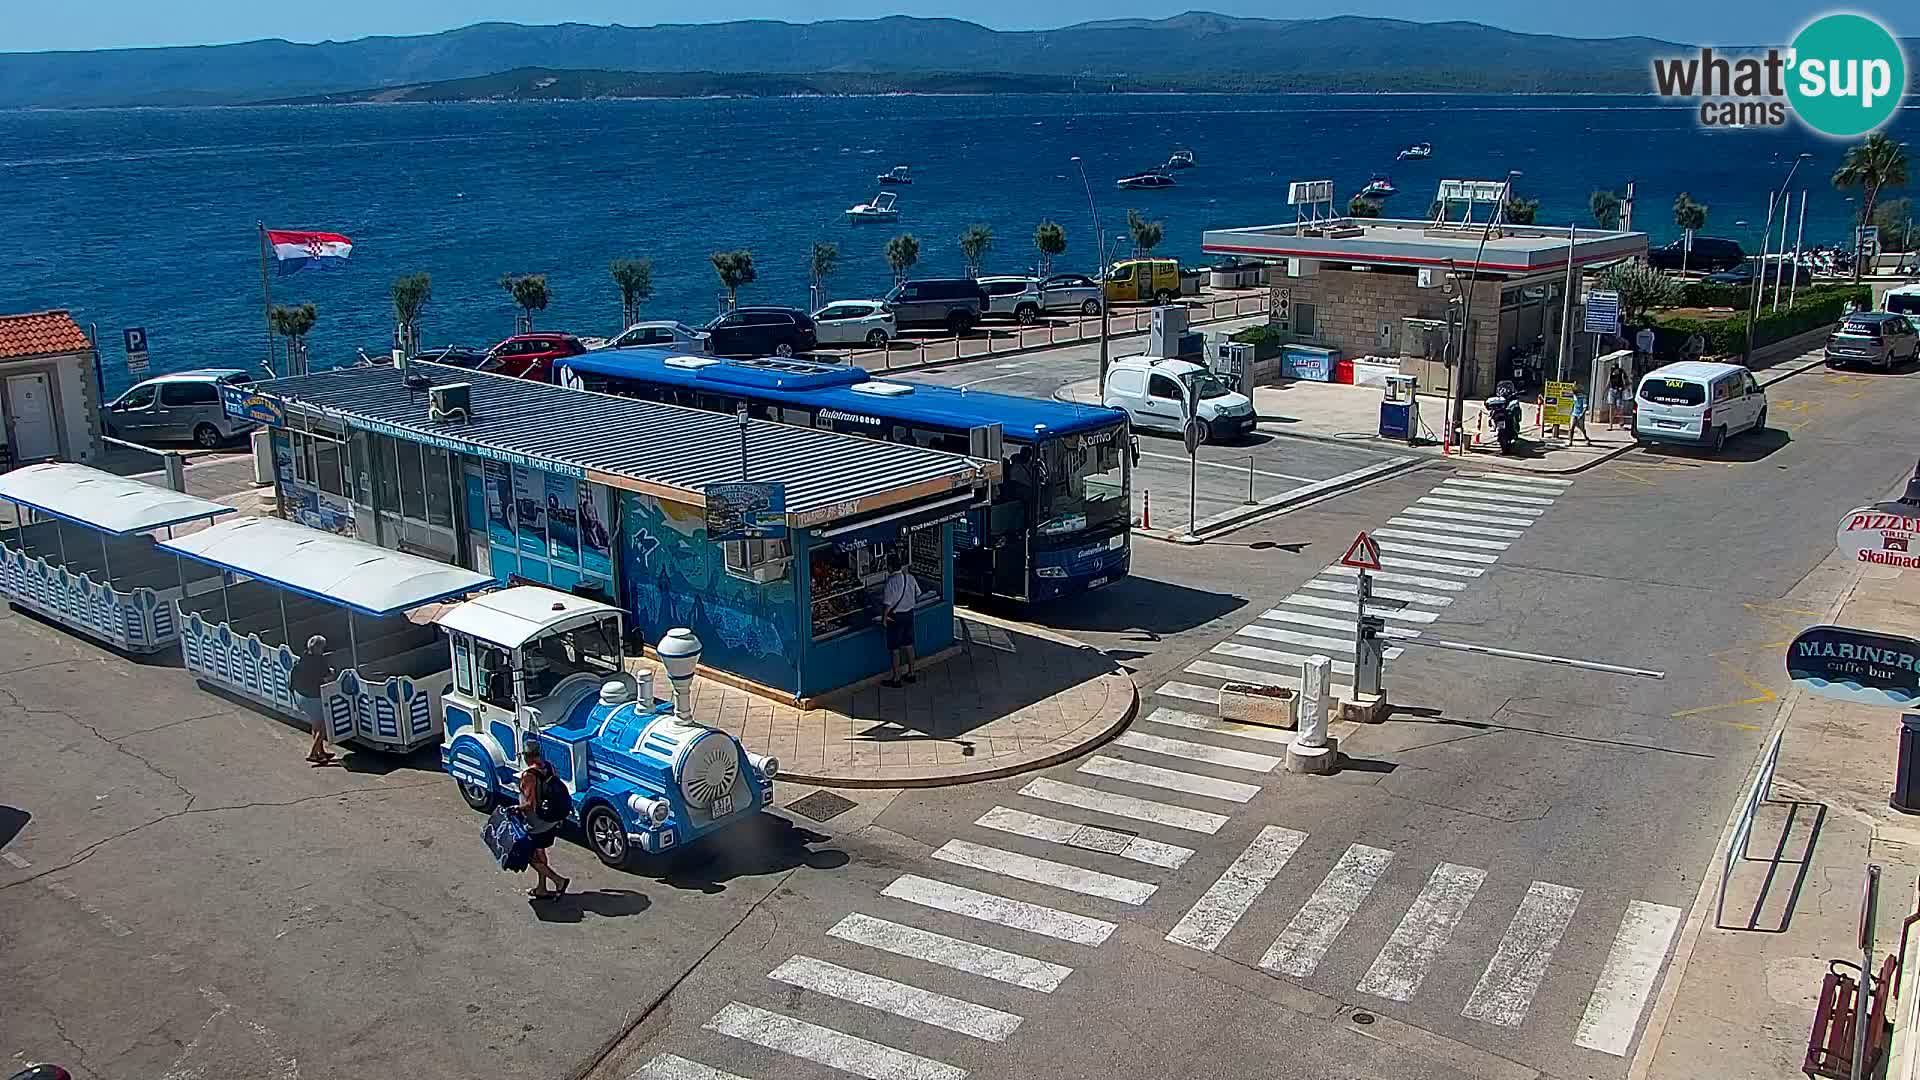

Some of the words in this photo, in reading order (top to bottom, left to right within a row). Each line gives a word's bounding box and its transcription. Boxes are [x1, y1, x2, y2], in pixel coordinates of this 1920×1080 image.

[129, 331, 141, 350] P
[1665, 380, 1684, 389] TAXI
[1088, 432, 1111, 446] arriva
[436, 438, 467, 452] POSTAJA
[477, 446, 492, 457] BUS
[493, 450, 524, 464] STATION
[528, 457, 553, 470] TICKET
[554, 464, 581, 477] OFFICE
[1880, 530, 1915, 540] GRILL
[1869, 665, 1895, 679] bar
